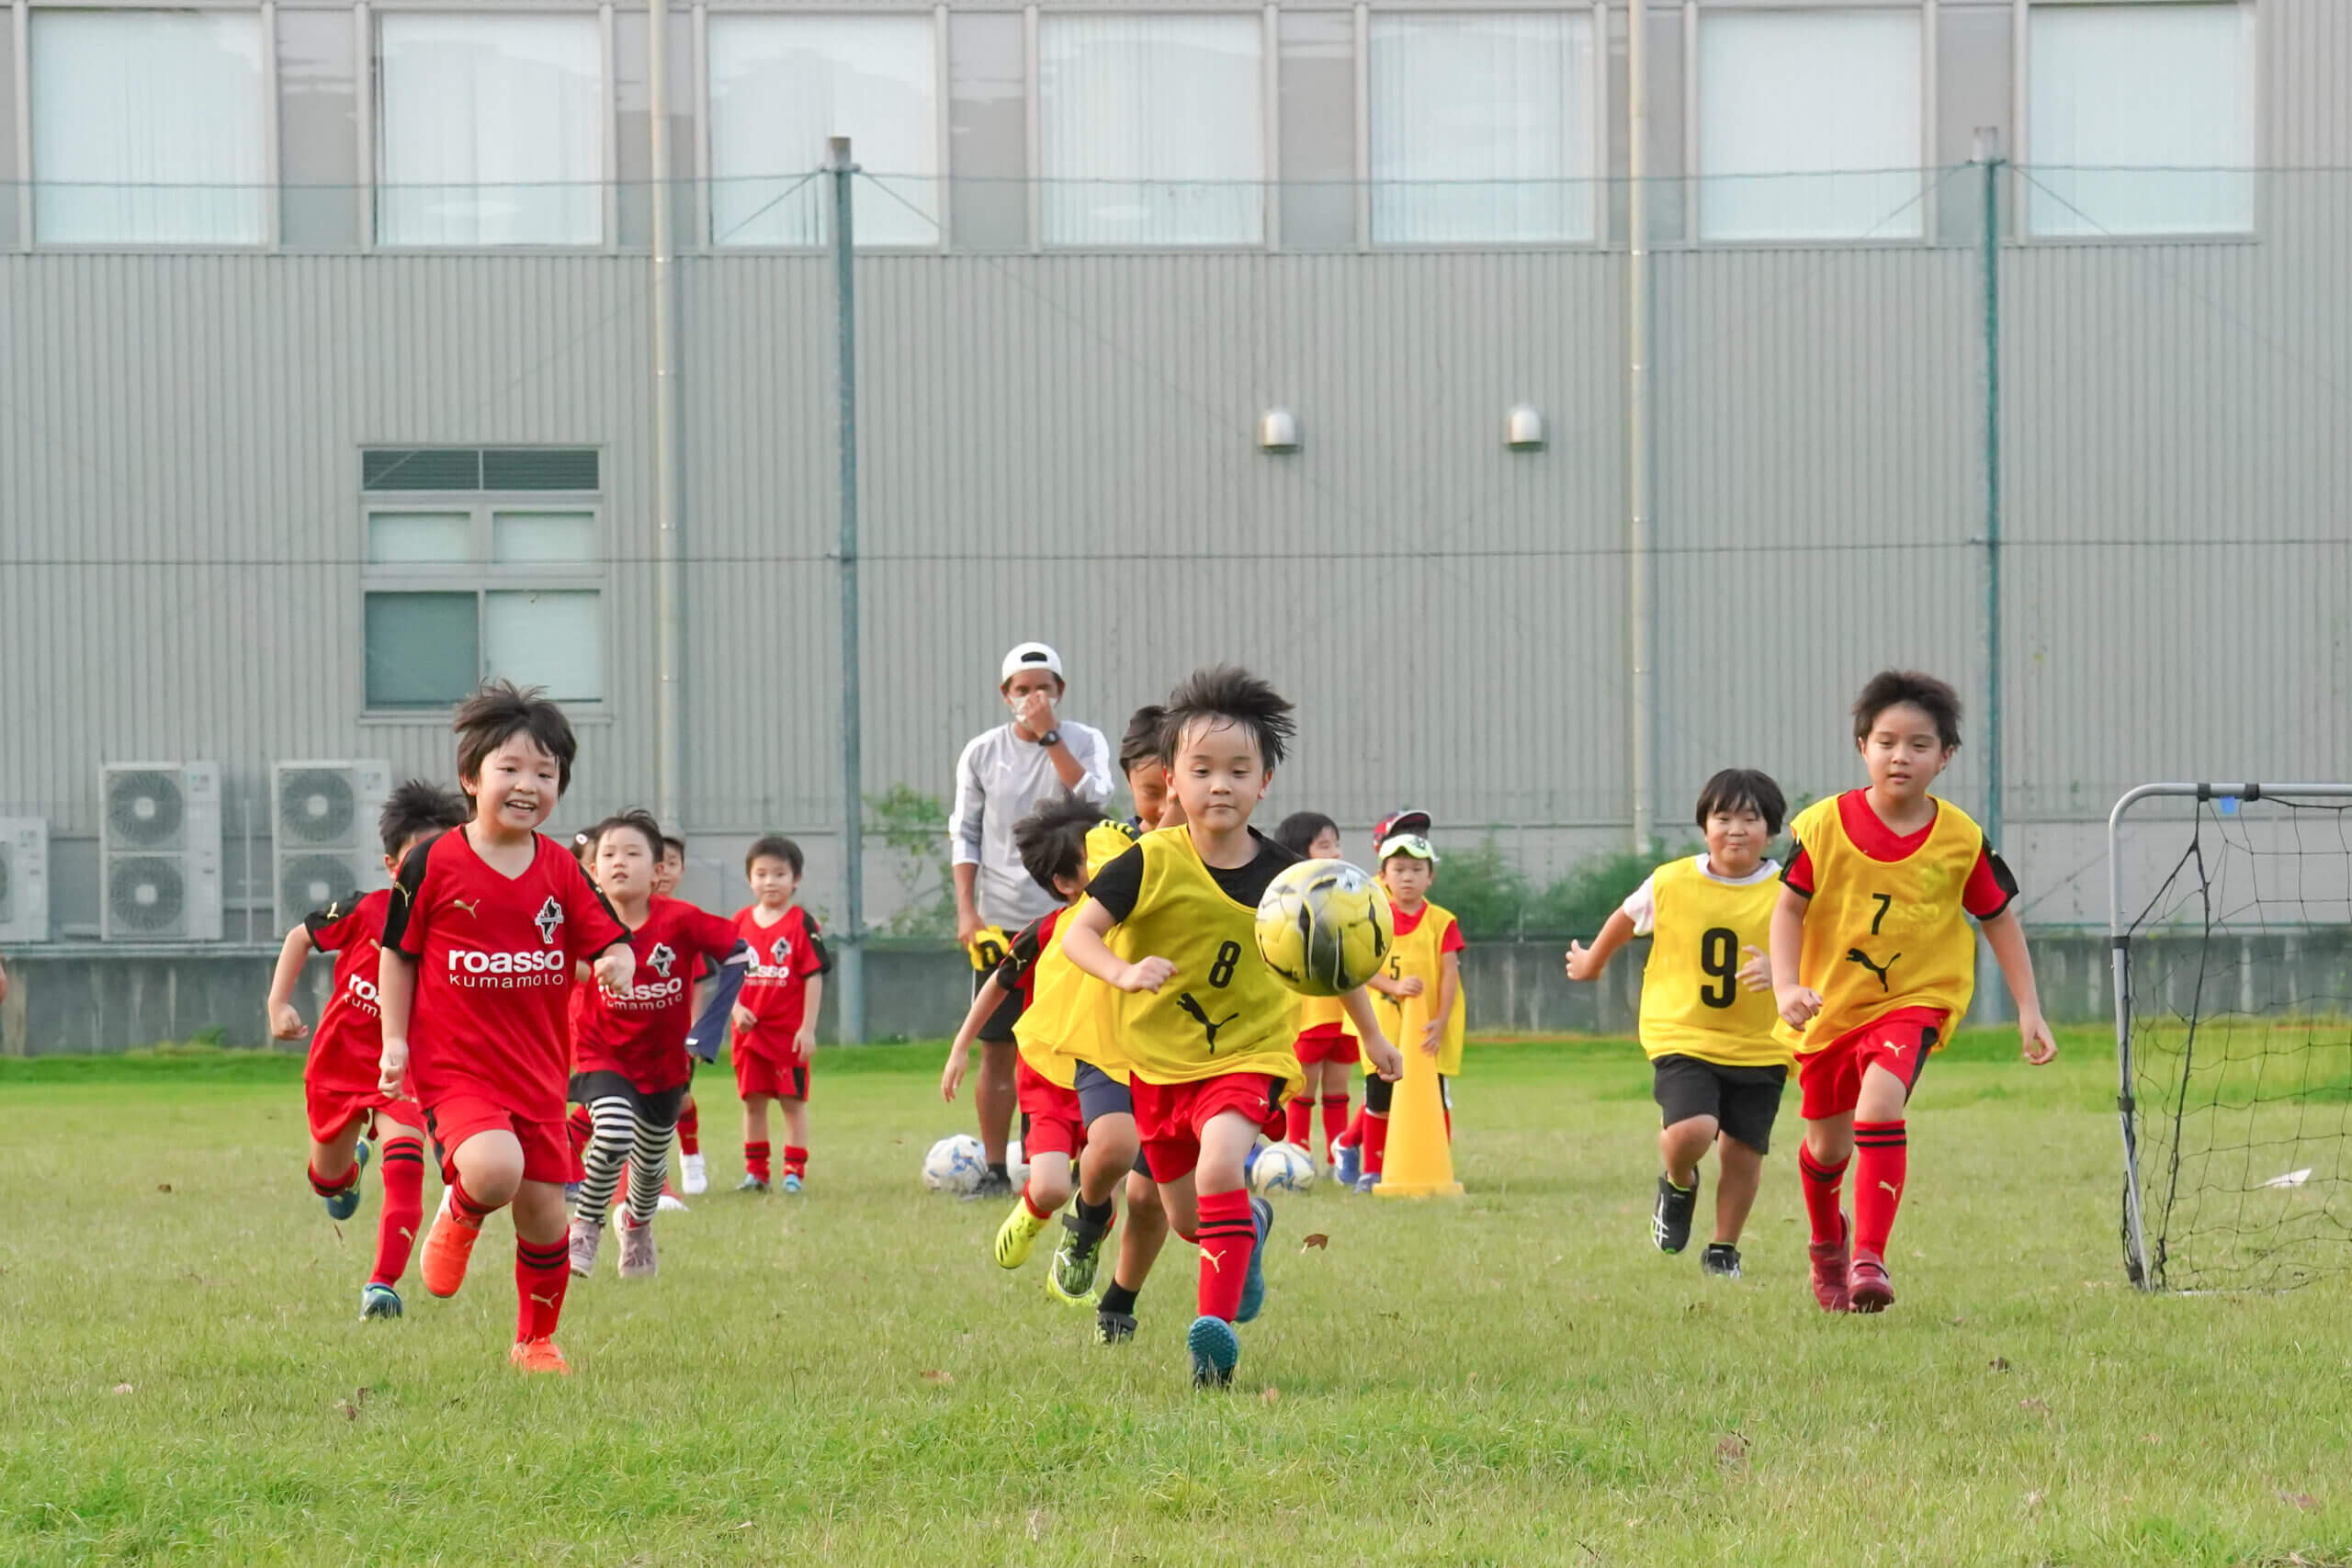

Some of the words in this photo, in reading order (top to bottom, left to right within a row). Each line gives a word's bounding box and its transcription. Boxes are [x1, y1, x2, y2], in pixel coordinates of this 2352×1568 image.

[1871, 892, 1892, 935] 7
[448, 949, 564, 974] roasso
[1208, 940, 1241, 988] 8
[1389, 955, 1400, 980] 5
[1701, 927, 1738, 1009] 9
[449, 974, 564, 988] kumamoto
